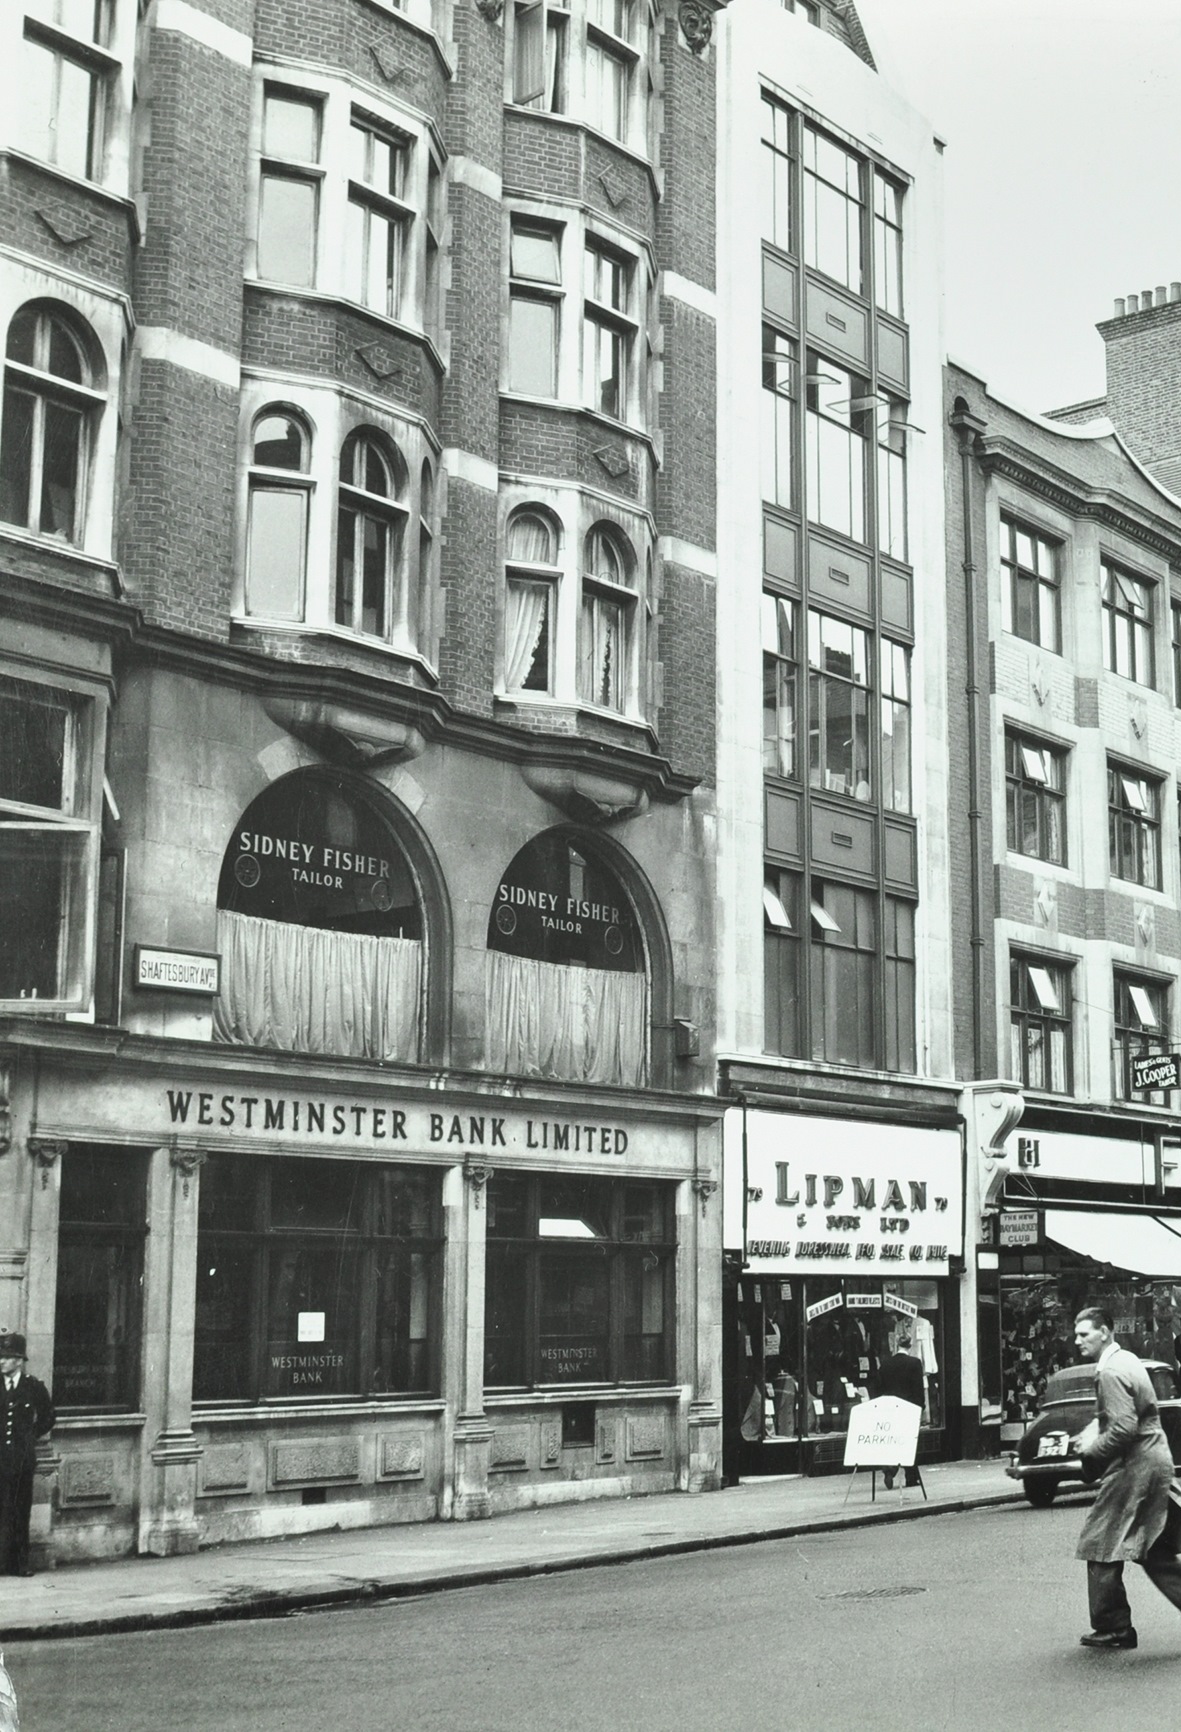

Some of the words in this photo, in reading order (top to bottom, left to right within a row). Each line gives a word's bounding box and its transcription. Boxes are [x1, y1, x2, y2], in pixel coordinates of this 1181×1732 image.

[240, 832, 314, 863] SIDNEY
[323, 848, 390, 878] FISHER
[291, 867, 343, 889] TAILOR
[499, 884, 558, 911] SIDNEY
[566, 898, 620, 924] FISHER
[541, 916, 582, 934] TAILOR
[141, 960, 199, 983] SHAFTESBURY
[167, 1090, 408, 1141] WESTMINSTER
[430, 1113, 507, 1147] BANK
[526, 1120, 629, 1155] LIMITED
[775, 1161, 928, 1211] LIPMAN
[880, 1217, 910, 1234] LTD
[1008, 1234, 1030, 1243] CLUB
[271, 1355, 344, 1368] WESTMINSTER
[541, 1347, 597, 1359] WESTMINSTER
[558, 1362, 581, 1373] BANK
[293, 1371, 322, 1384] BANK
[874, 1422, 891, 1432] NO
